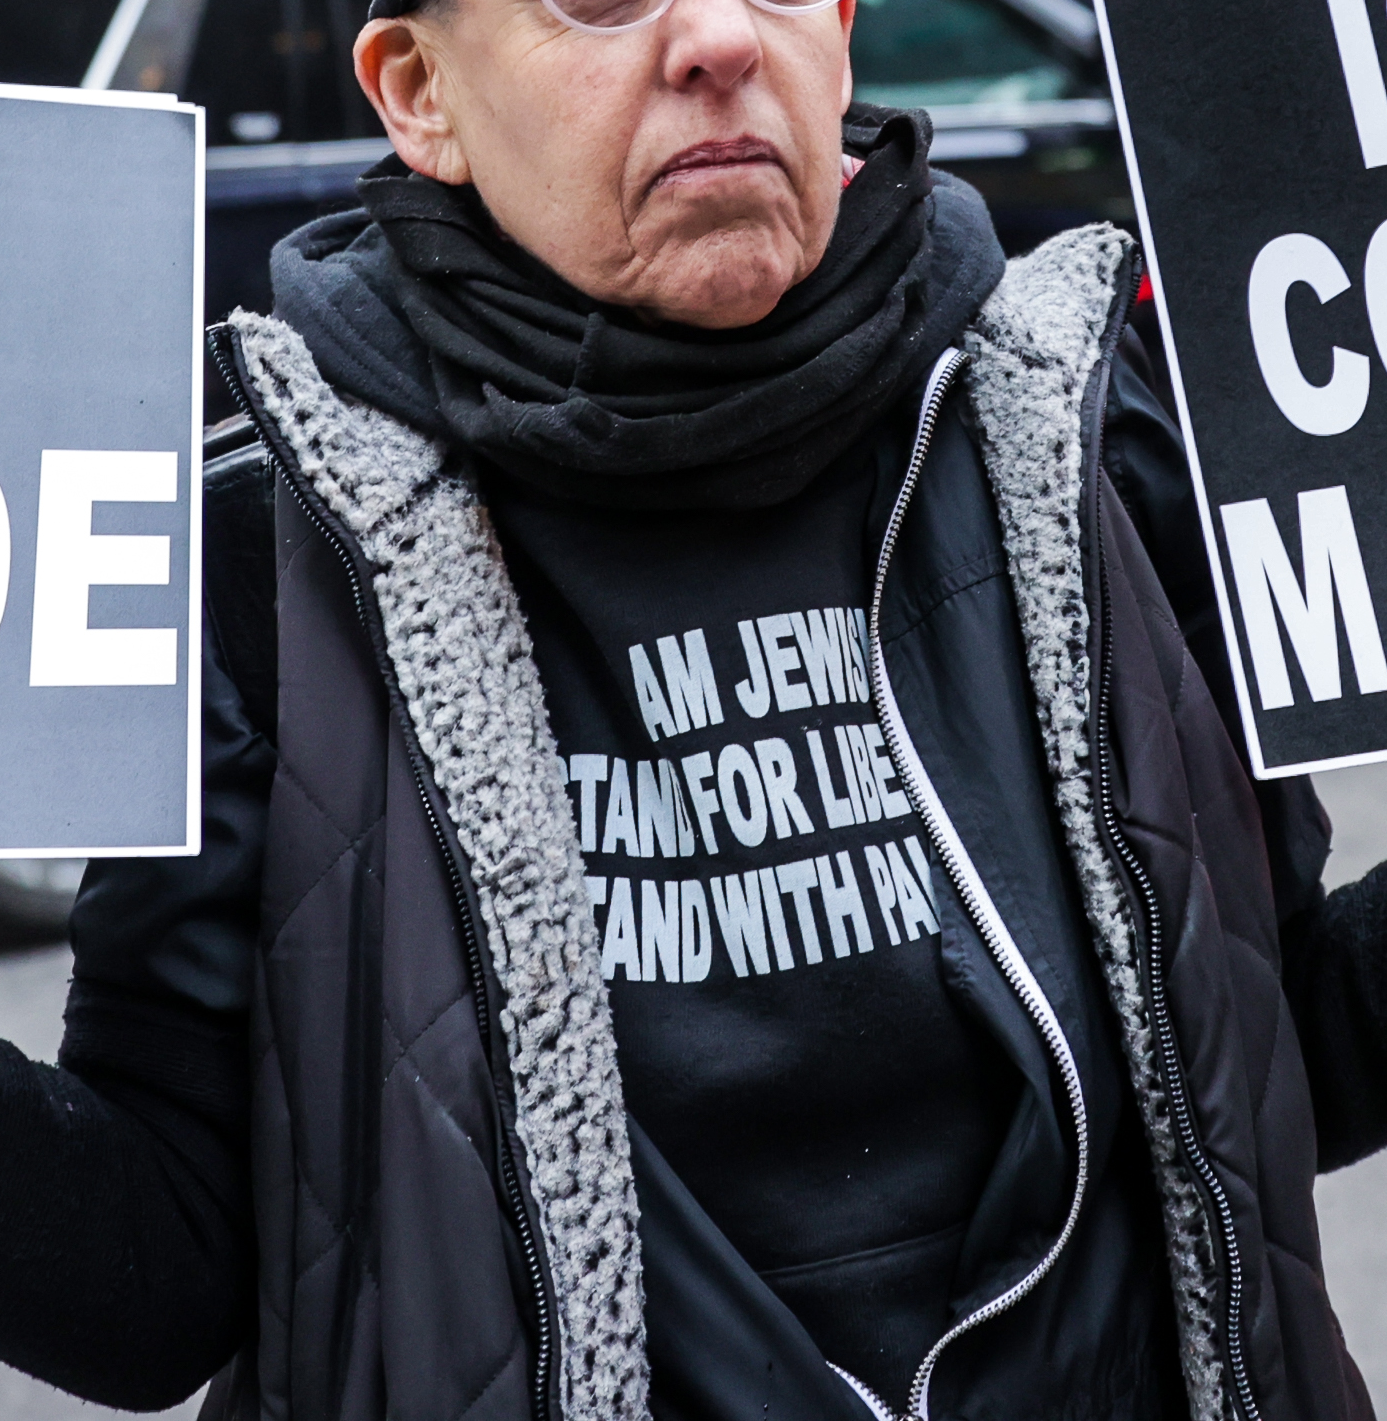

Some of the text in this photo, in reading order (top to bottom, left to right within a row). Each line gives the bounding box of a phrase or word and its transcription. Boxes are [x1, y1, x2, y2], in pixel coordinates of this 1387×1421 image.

[628, 628, 725, 742] AM
[558, 724, 913, 858] TAND FOR LIBE
[709, 849, 875, 978] WITH
